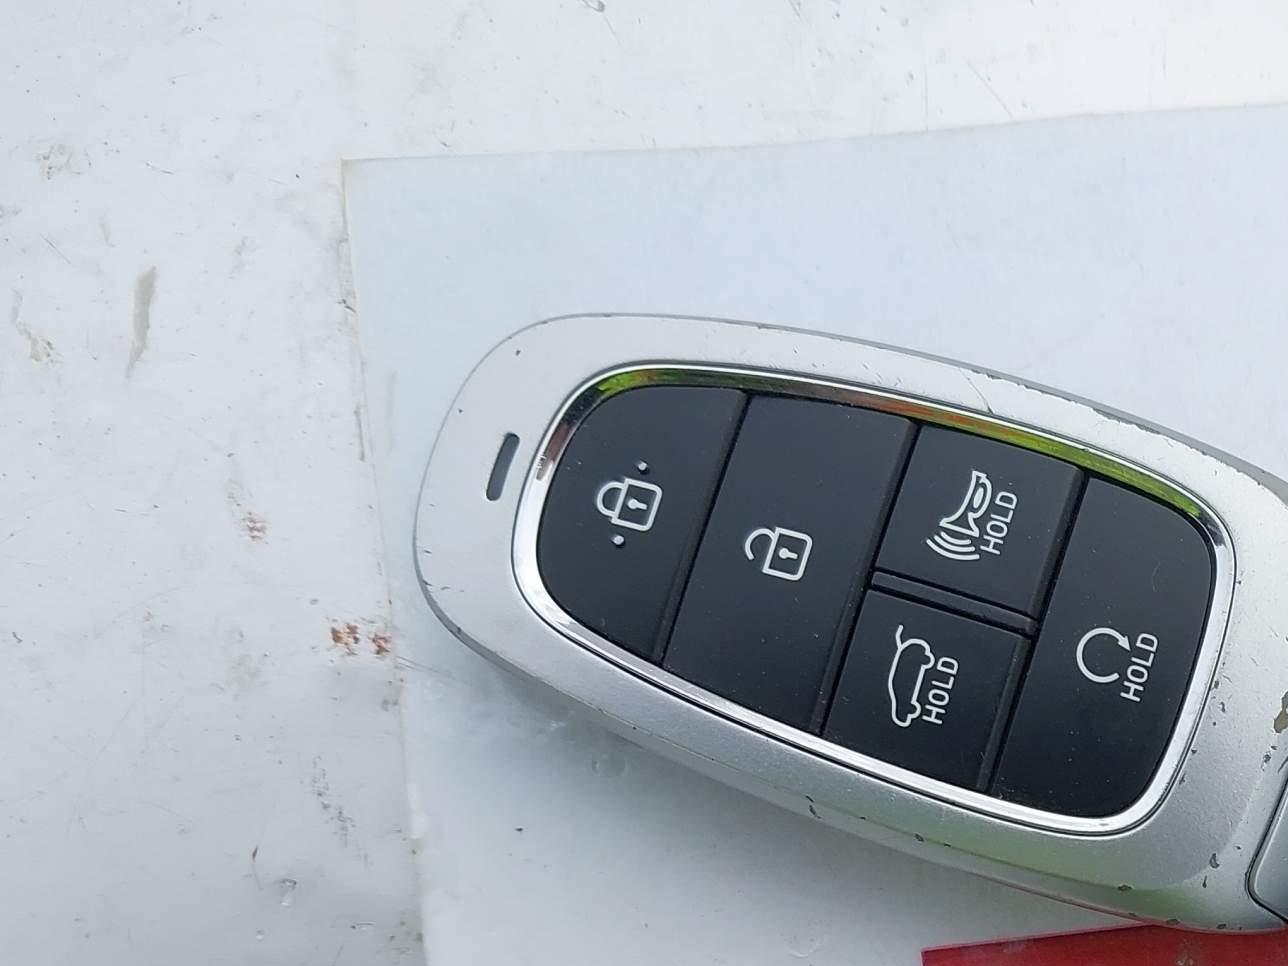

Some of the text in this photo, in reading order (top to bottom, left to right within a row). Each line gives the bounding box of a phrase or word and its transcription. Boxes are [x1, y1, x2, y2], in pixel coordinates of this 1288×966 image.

[979, 490, 1018, 555] HOLD
[921, 656, 959, 725] HOLD
[1119, 631, 1159, 702] HOLD
